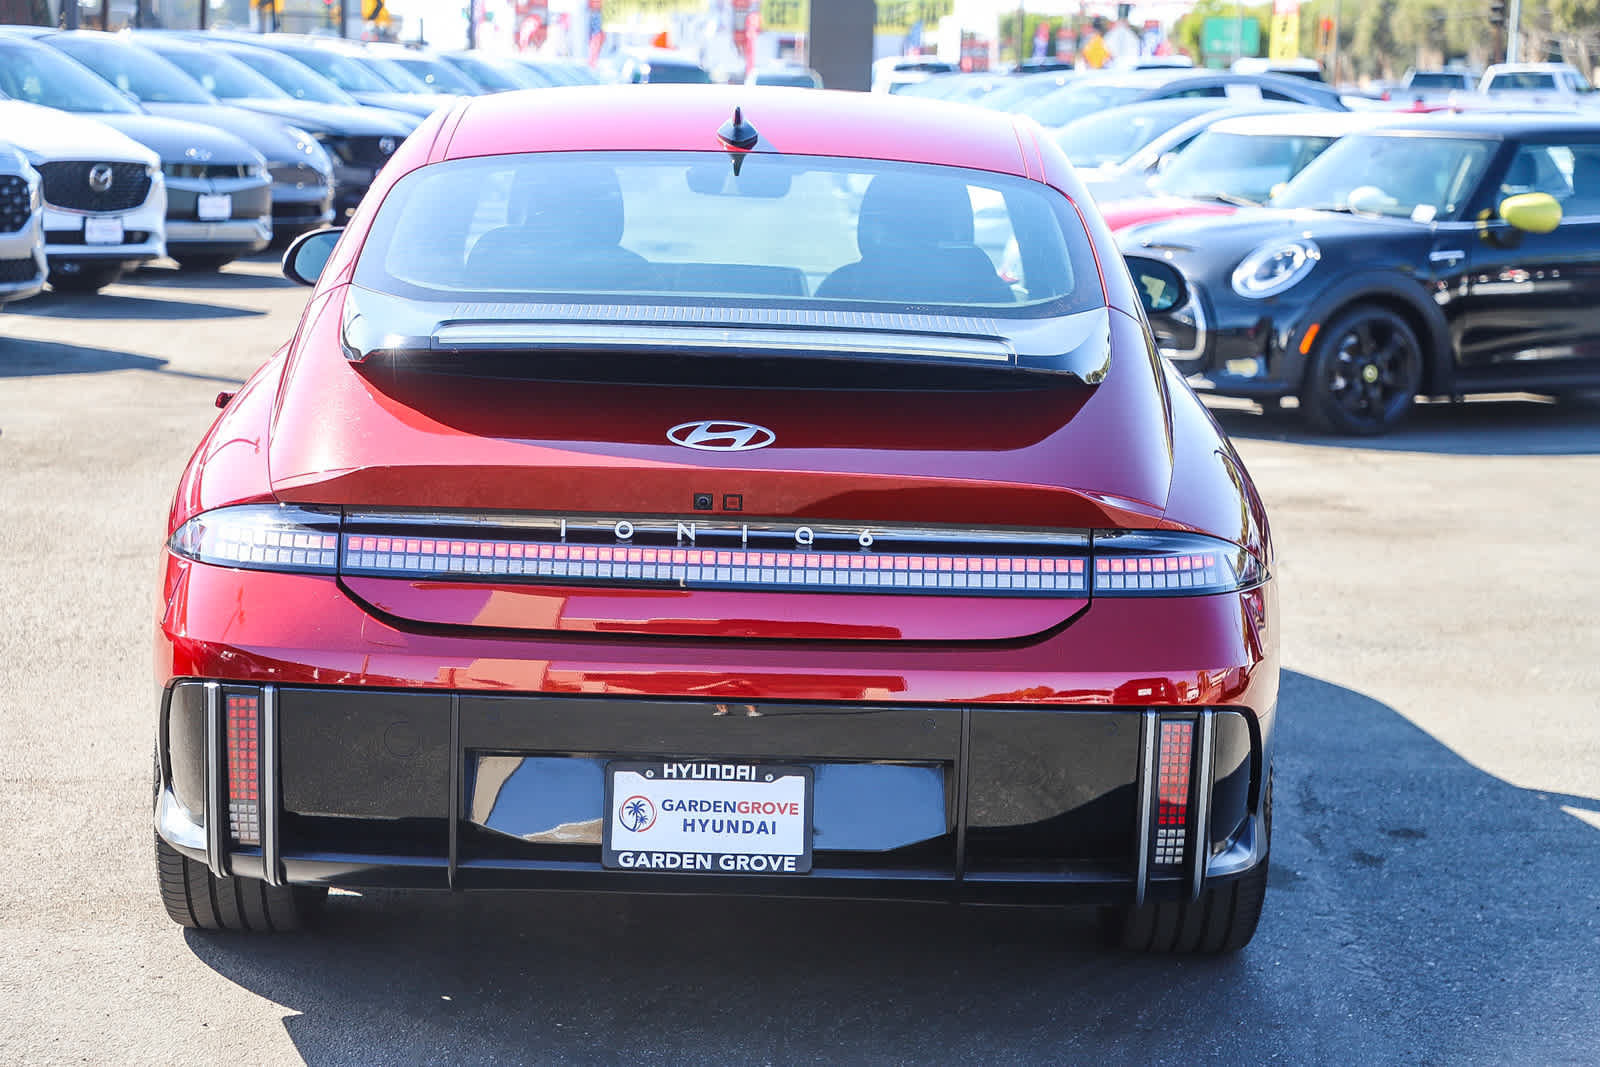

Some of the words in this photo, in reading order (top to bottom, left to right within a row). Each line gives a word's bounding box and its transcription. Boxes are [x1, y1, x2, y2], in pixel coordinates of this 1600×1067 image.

[662, 763, 756, 780] HYUNDAI
[683, 818, 777, 835] HYUNDAI
[618, 852, 711, 869] GARDEN
[719, 854, 796, 871] GROVE
